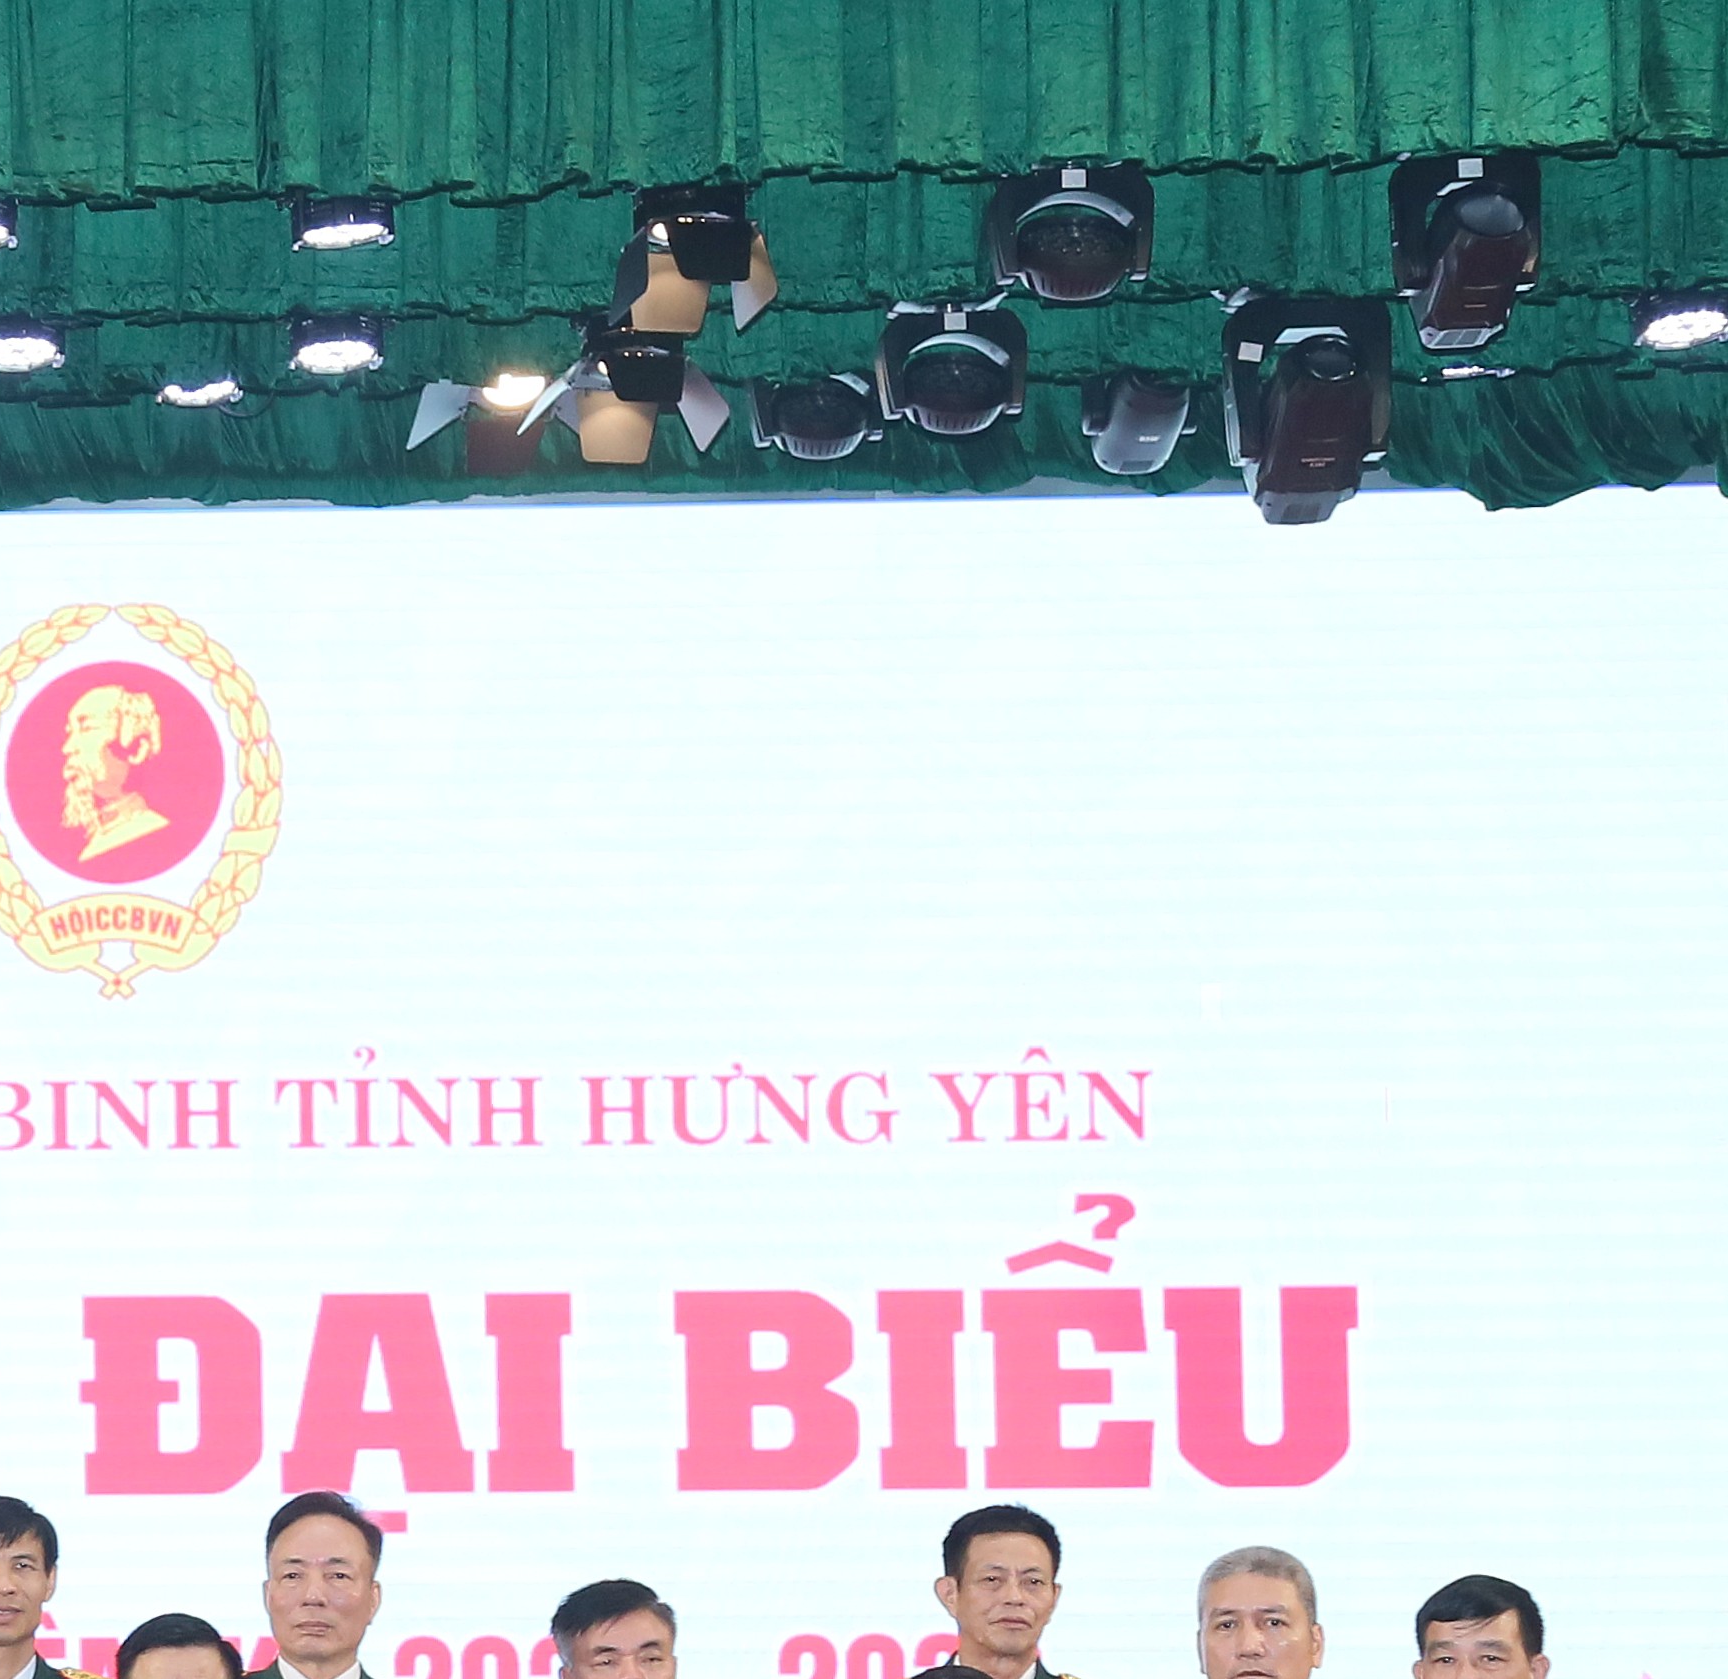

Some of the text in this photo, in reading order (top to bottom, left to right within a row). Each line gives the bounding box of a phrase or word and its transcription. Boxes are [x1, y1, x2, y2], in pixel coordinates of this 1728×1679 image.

[275, 1046, 541, 1149] TỈNH
[582, 1062, 899, 1146] HƯNG
[930, 1046, 1152, 1143] YÊN
[79, 1291, 575, 1534] ĐẠI
[674, 1192, 1360, 1492] BIỂU
